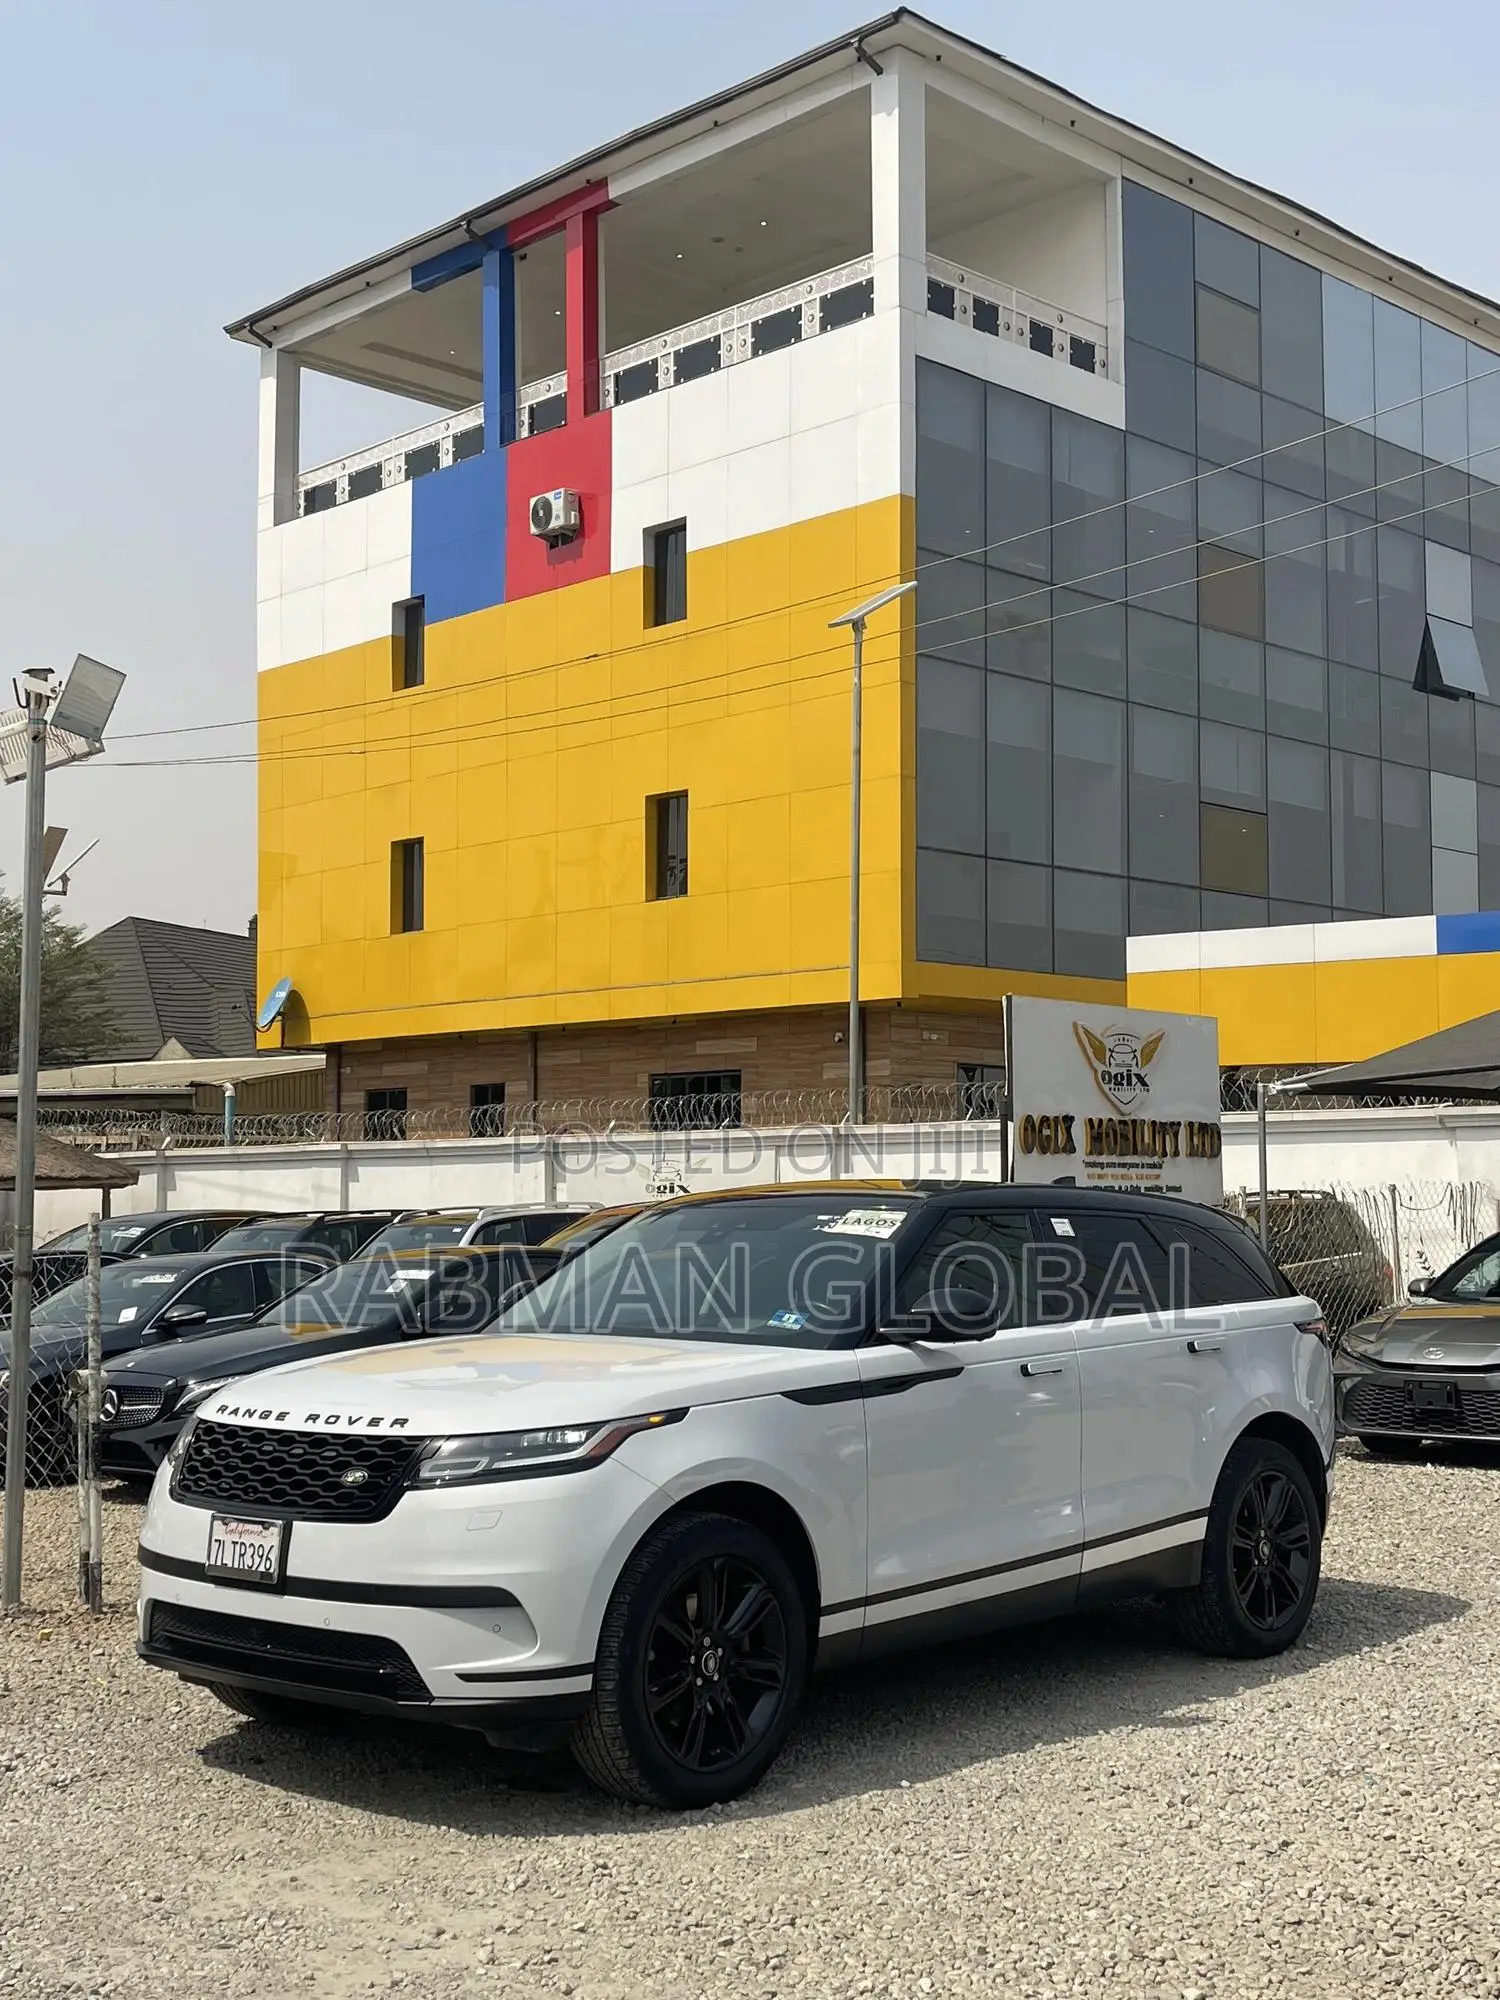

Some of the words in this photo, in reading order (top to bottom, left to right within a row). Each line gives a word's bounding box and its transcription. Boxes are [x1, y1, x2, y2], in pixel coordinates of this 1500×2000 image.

[1019, 1114, 1077, 1156] OGIX
[1084, 1117, 1182, 1159] MOBILITY
[1184, 1120, 1222, 1159] LTD
[842, 1217, 897, 1228] LAGOS
[216, 1404, 290, 1421] RANGE
[304, 1413, 410, 1428] ROVER
[224, 1522, 265, 1540] California
[213, 1539, 274, 1572] 7LTR396
